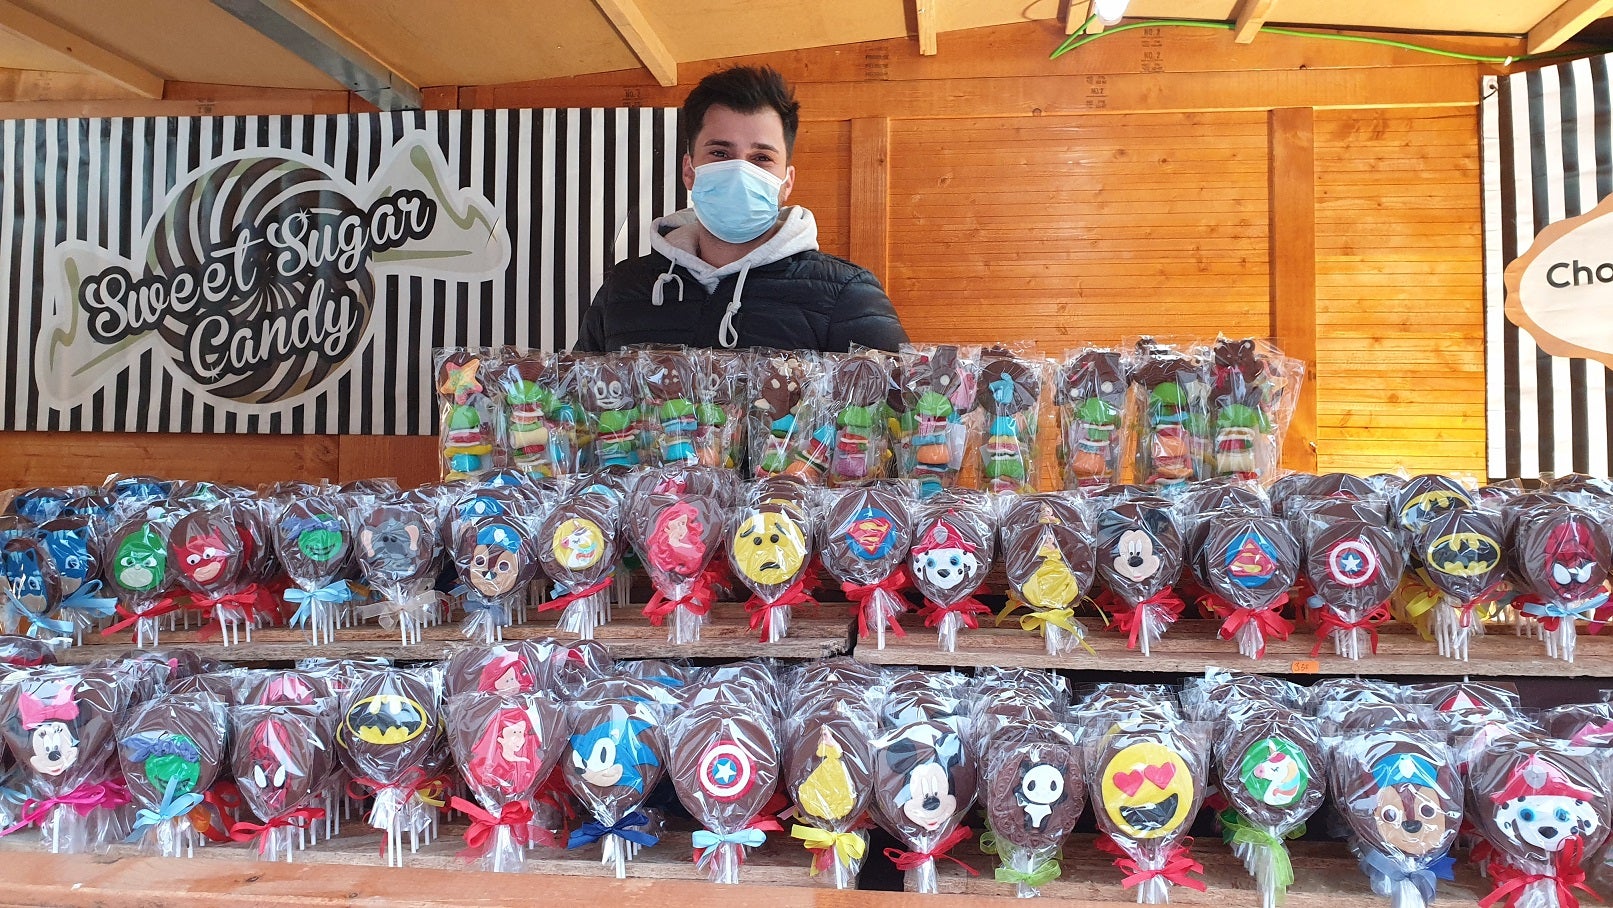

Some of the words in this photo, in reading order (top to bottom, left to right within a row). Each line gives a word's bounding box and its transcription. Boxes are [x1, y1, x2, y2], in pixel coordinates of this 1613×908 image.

[85, 228, 264, 337] Sweet
[266, 195, 430, 277] Sugar
[1546, 259, 1613, 289] Cho
[189, 278, 357, 380] Candy
